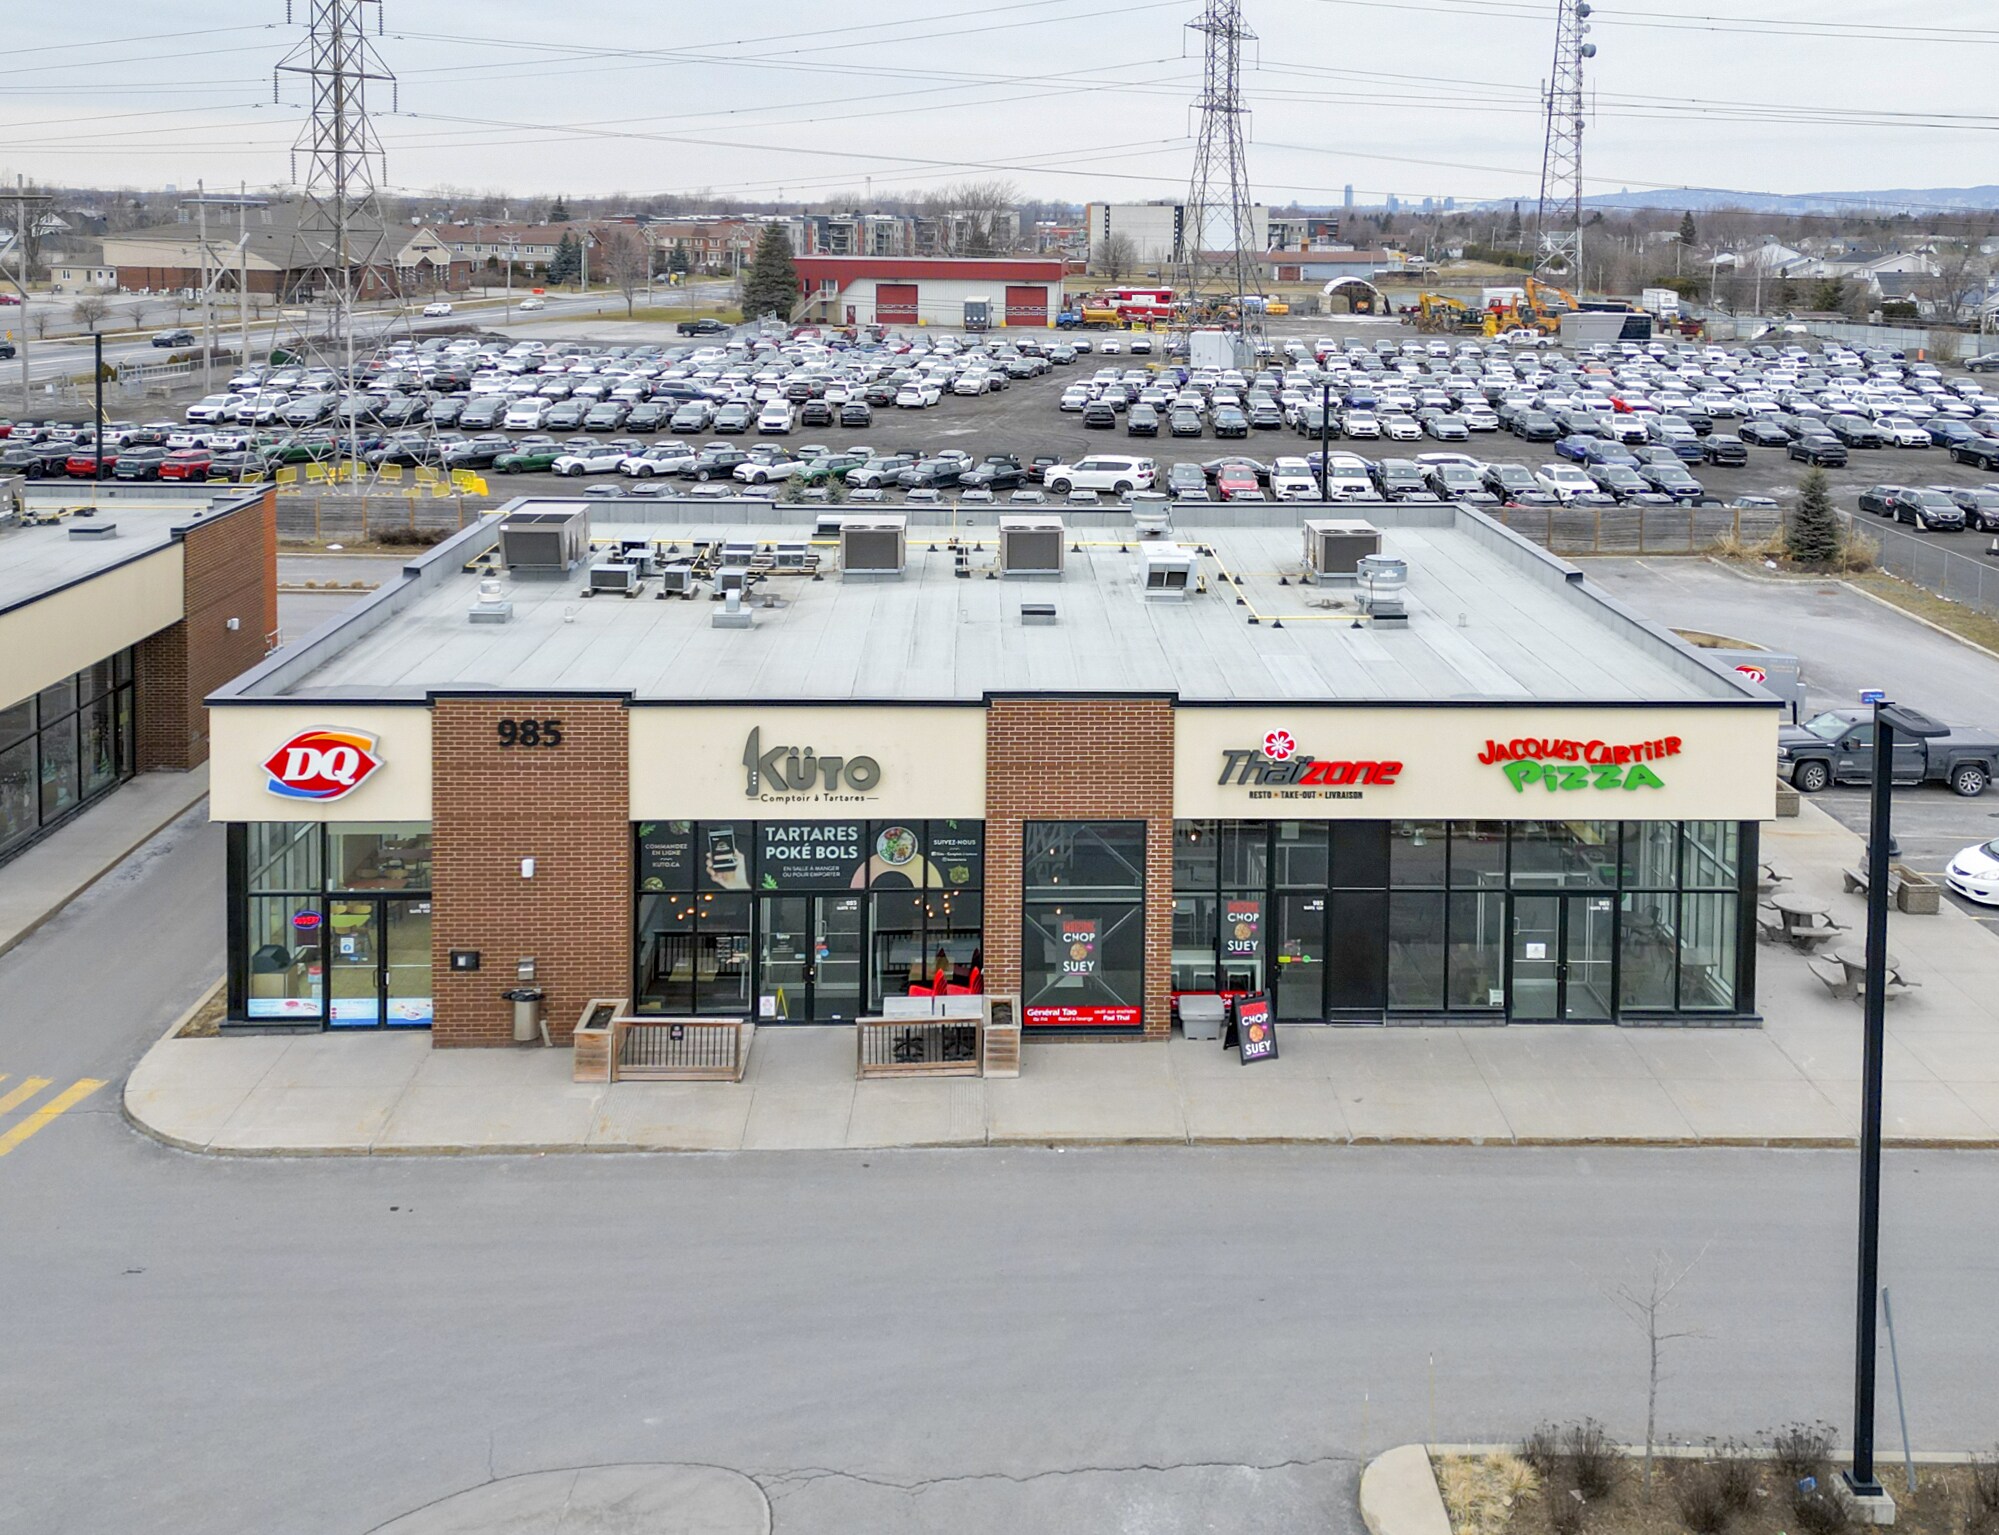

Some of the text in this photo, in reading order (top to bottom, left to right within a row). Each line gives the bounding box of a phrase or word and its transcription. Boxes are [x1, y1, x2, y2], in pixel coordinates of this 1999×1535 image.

[497, 719, 562, 747] 985
[1477, 737, 1585, 765] JACQUES
[282, 746, 360, 785] DQ
[760, 793, 811, 805] Comptoir
[823, 793, 865, 802] Tartares
[1249, 791, 1363, 799] RESTO TAKE-OUT LIVRAISON
[765, 826, 859, 841] TARTARES
[765, 842, 859, 860] POKÉ BOLS
[1227, 913, 1259, 922] CHOP
[1063, 932, 1096, 942] CHOP
[1227, 940, 1259, 951] SUEY
[1063, 960, 1095, 972] SUEY
[1062, 1008, 1077, 1016] Tao
[1241, 1013, 1268, 1026] CHOP
[1245, 1040, 1271, 1055] SUEY
